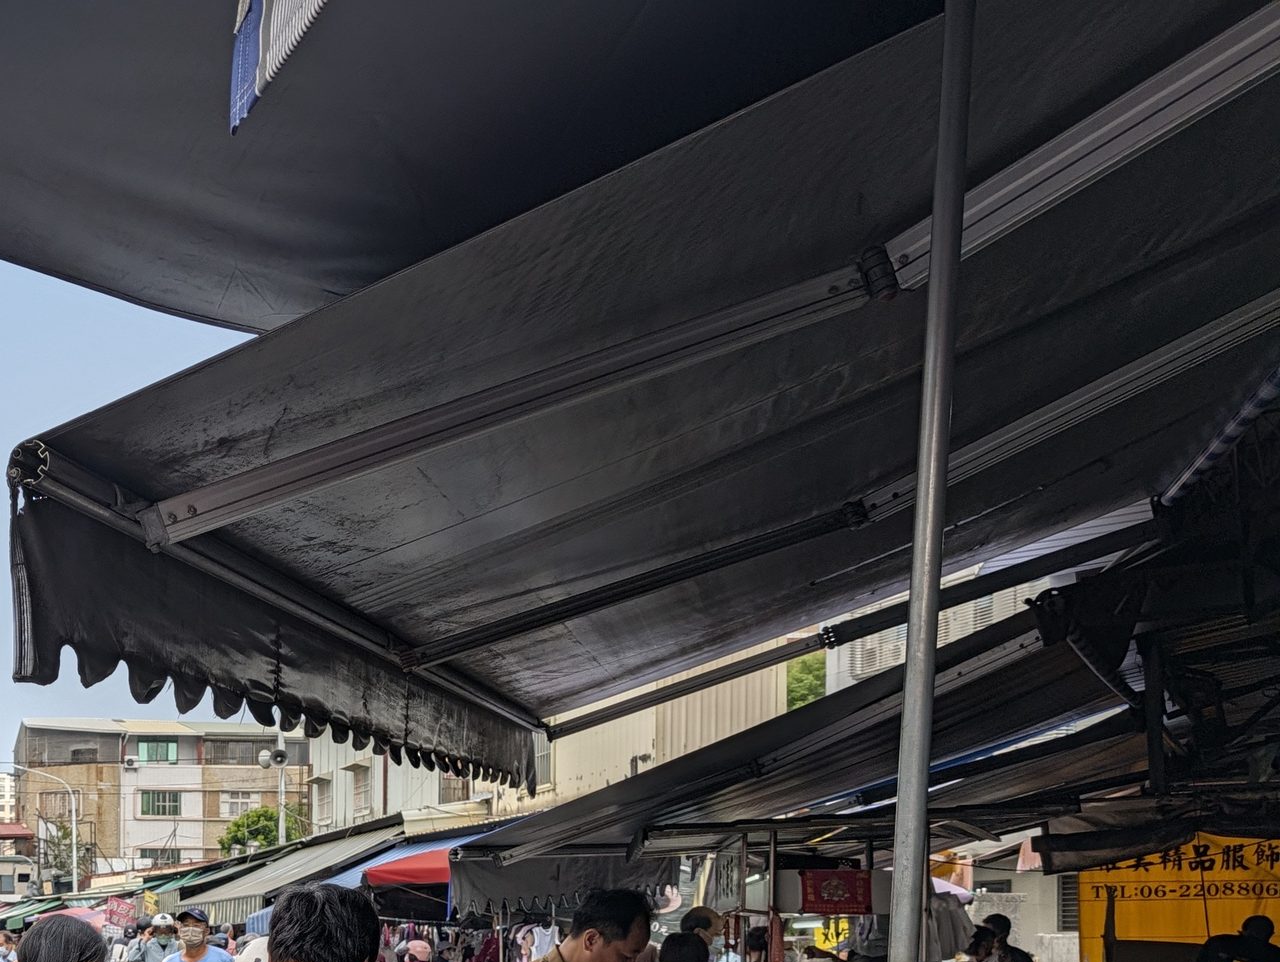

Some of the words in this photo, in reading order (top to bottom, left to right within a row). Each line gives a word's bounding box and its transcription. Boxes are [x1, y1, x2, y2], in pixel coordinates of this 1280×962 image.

[1100, 843, 1280, 873] 美精品服飾
